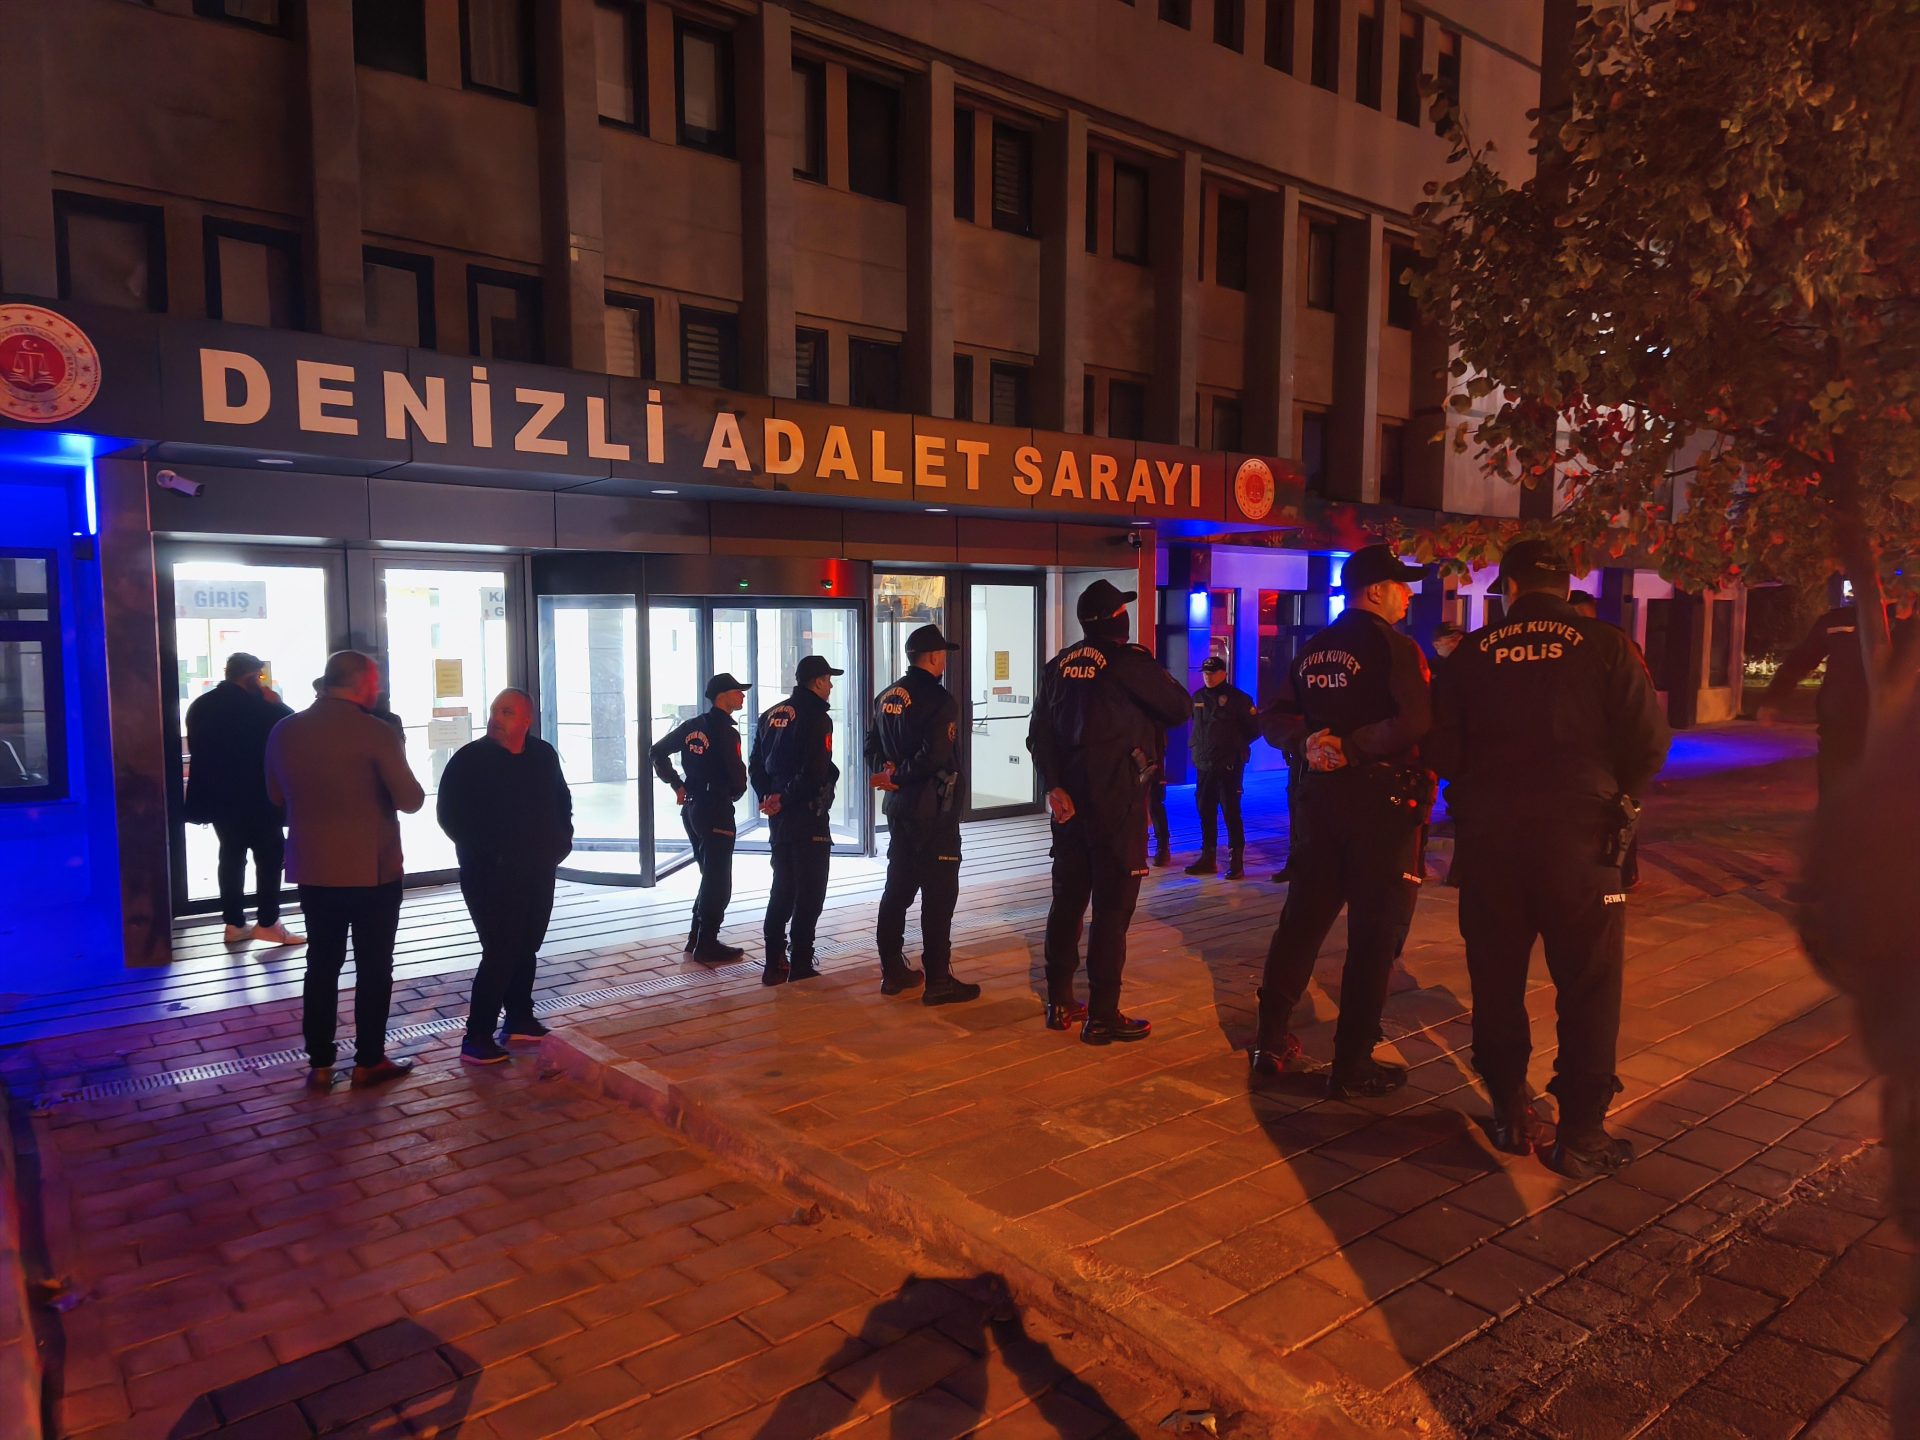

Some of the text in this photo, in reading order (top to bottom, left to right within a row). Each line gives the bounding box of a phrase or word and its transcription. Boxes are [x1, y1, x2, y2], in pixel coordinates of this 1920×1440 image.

[200, 348, 665, 464] DENİZLİ
[702, 411, 990, 490] ADALET
[1013, 446, 1200, 507] SARAYI
[194, 586, 250, 613] GİRİŞ
[1526, 620, 1584, 646] KUVVET
